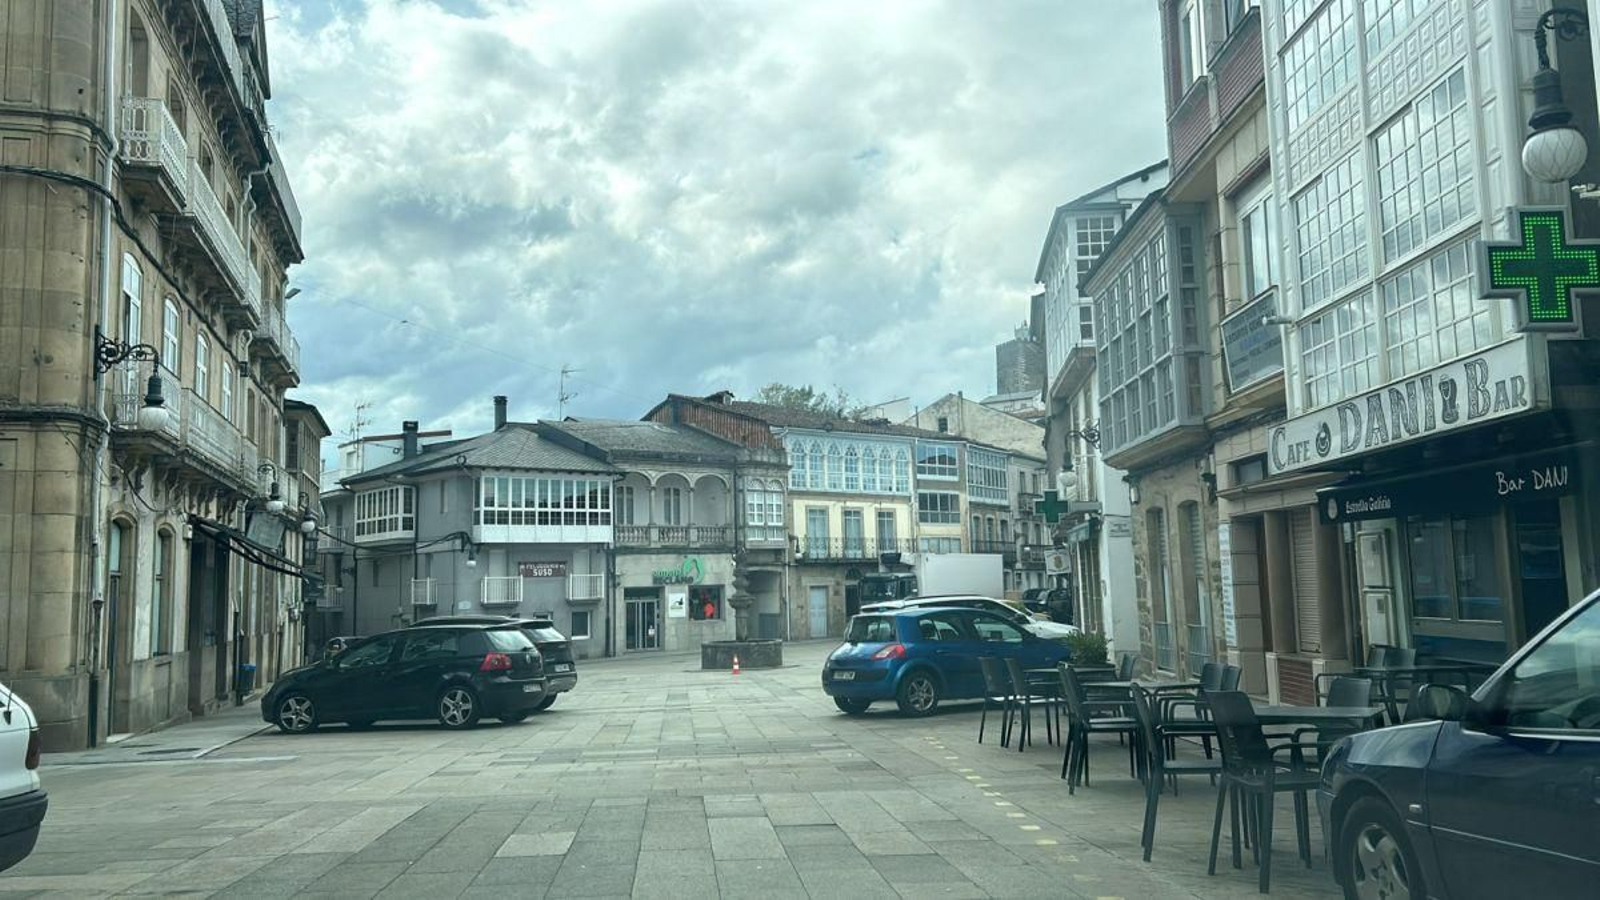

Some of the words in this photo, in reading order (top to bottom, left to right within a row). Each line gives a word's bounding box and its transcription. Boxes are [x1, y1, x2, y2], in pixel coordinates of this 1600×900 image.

[1272, 427, 1310, 471] CAFE
[1337, 374, 1436, 454] DANI
[1464, 358, 1527, 420] BAR
[1496, 471, 1526, 495] Bar
[1532, 466, 1567, 490] DANI
[533, 569, 553, 577] SUSO
